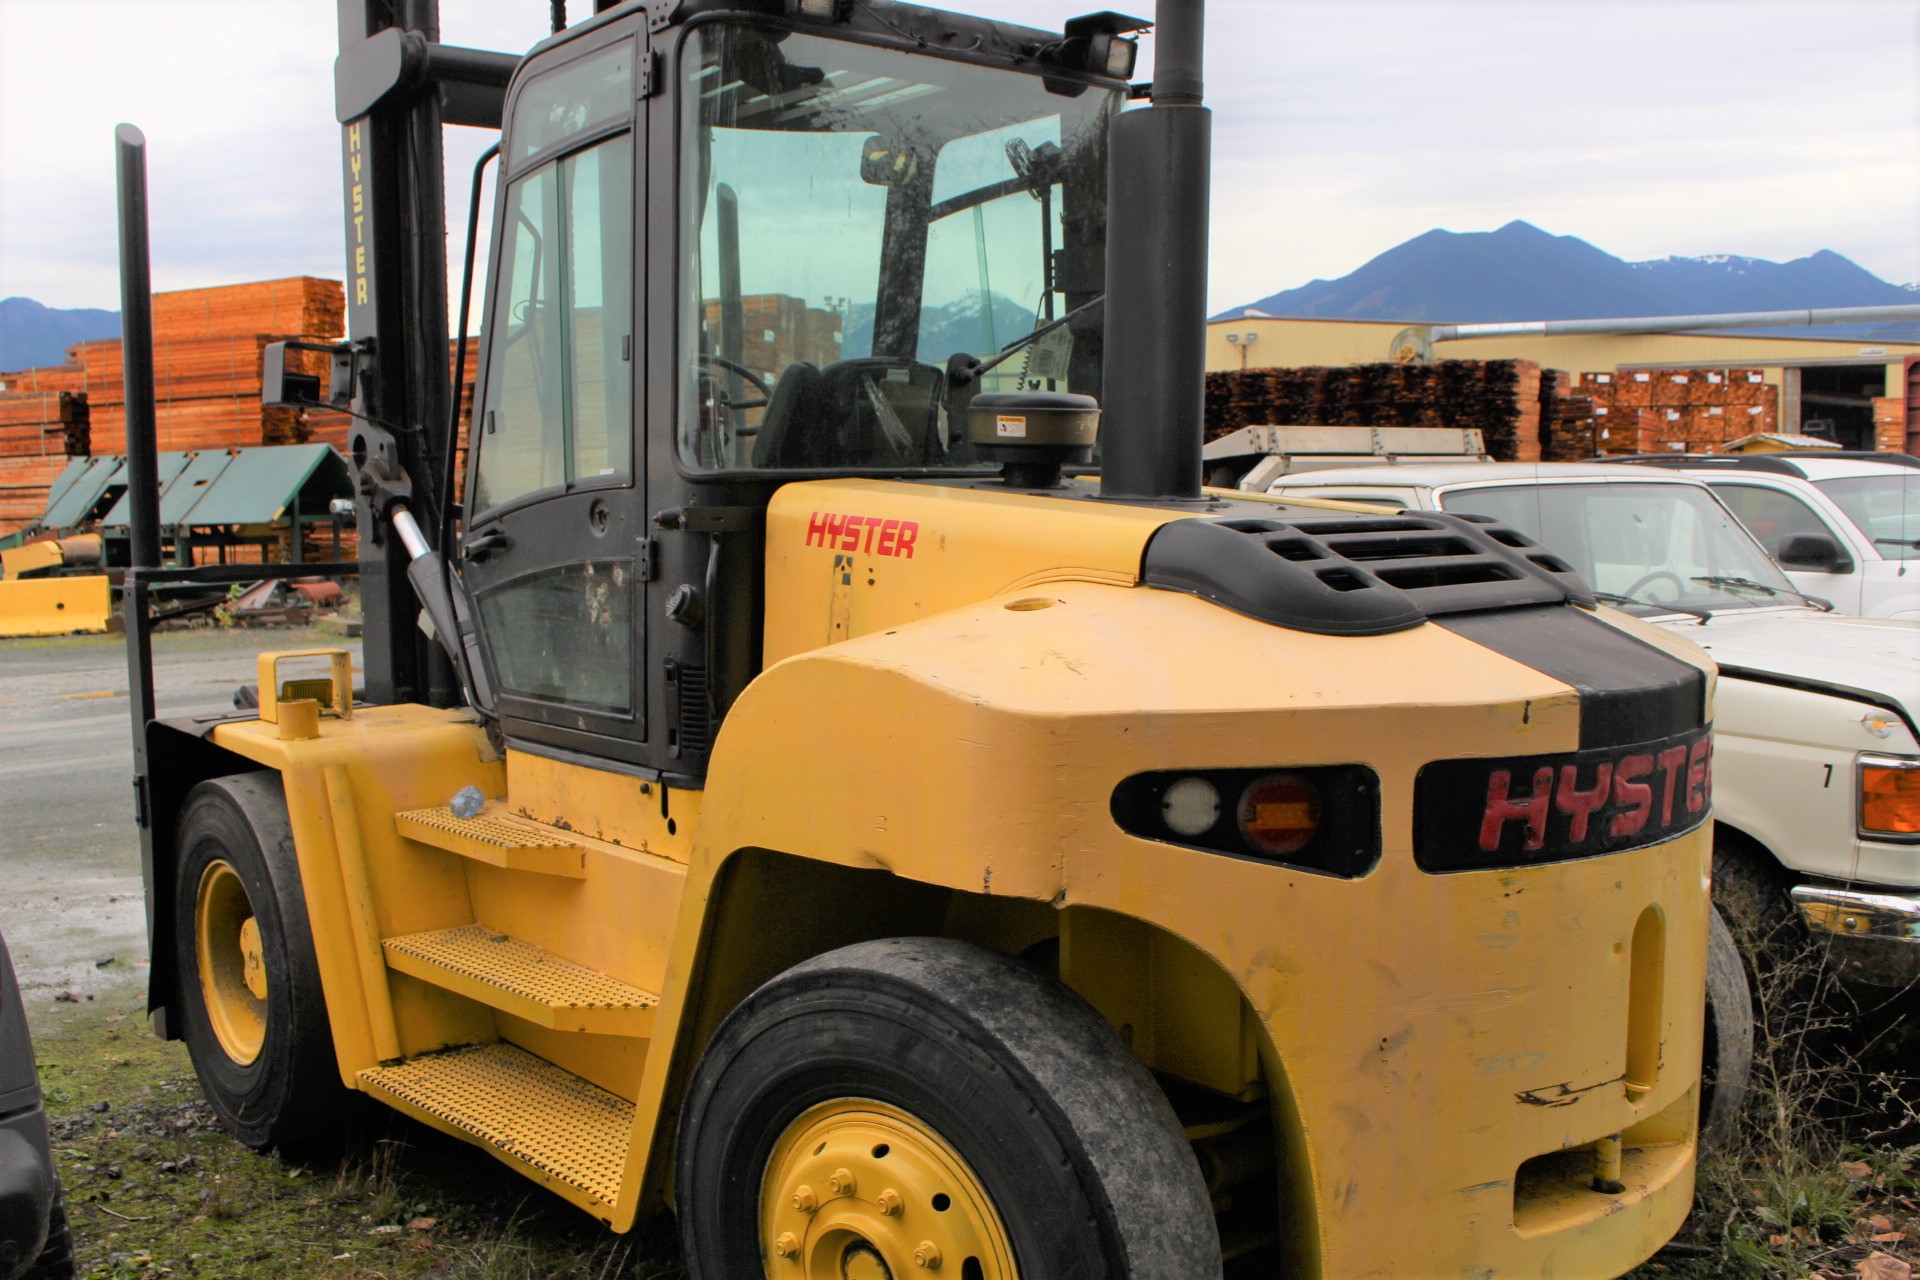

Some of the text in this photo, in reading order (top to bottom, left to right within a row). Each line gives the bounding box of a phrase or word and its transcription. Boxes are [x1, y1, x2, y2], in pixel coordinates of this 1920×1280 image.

[349, 122, 368, 306] HYSTER
[805, 511, 919, 559] HYSTER
[1823, 763, 1833, 788] 7
